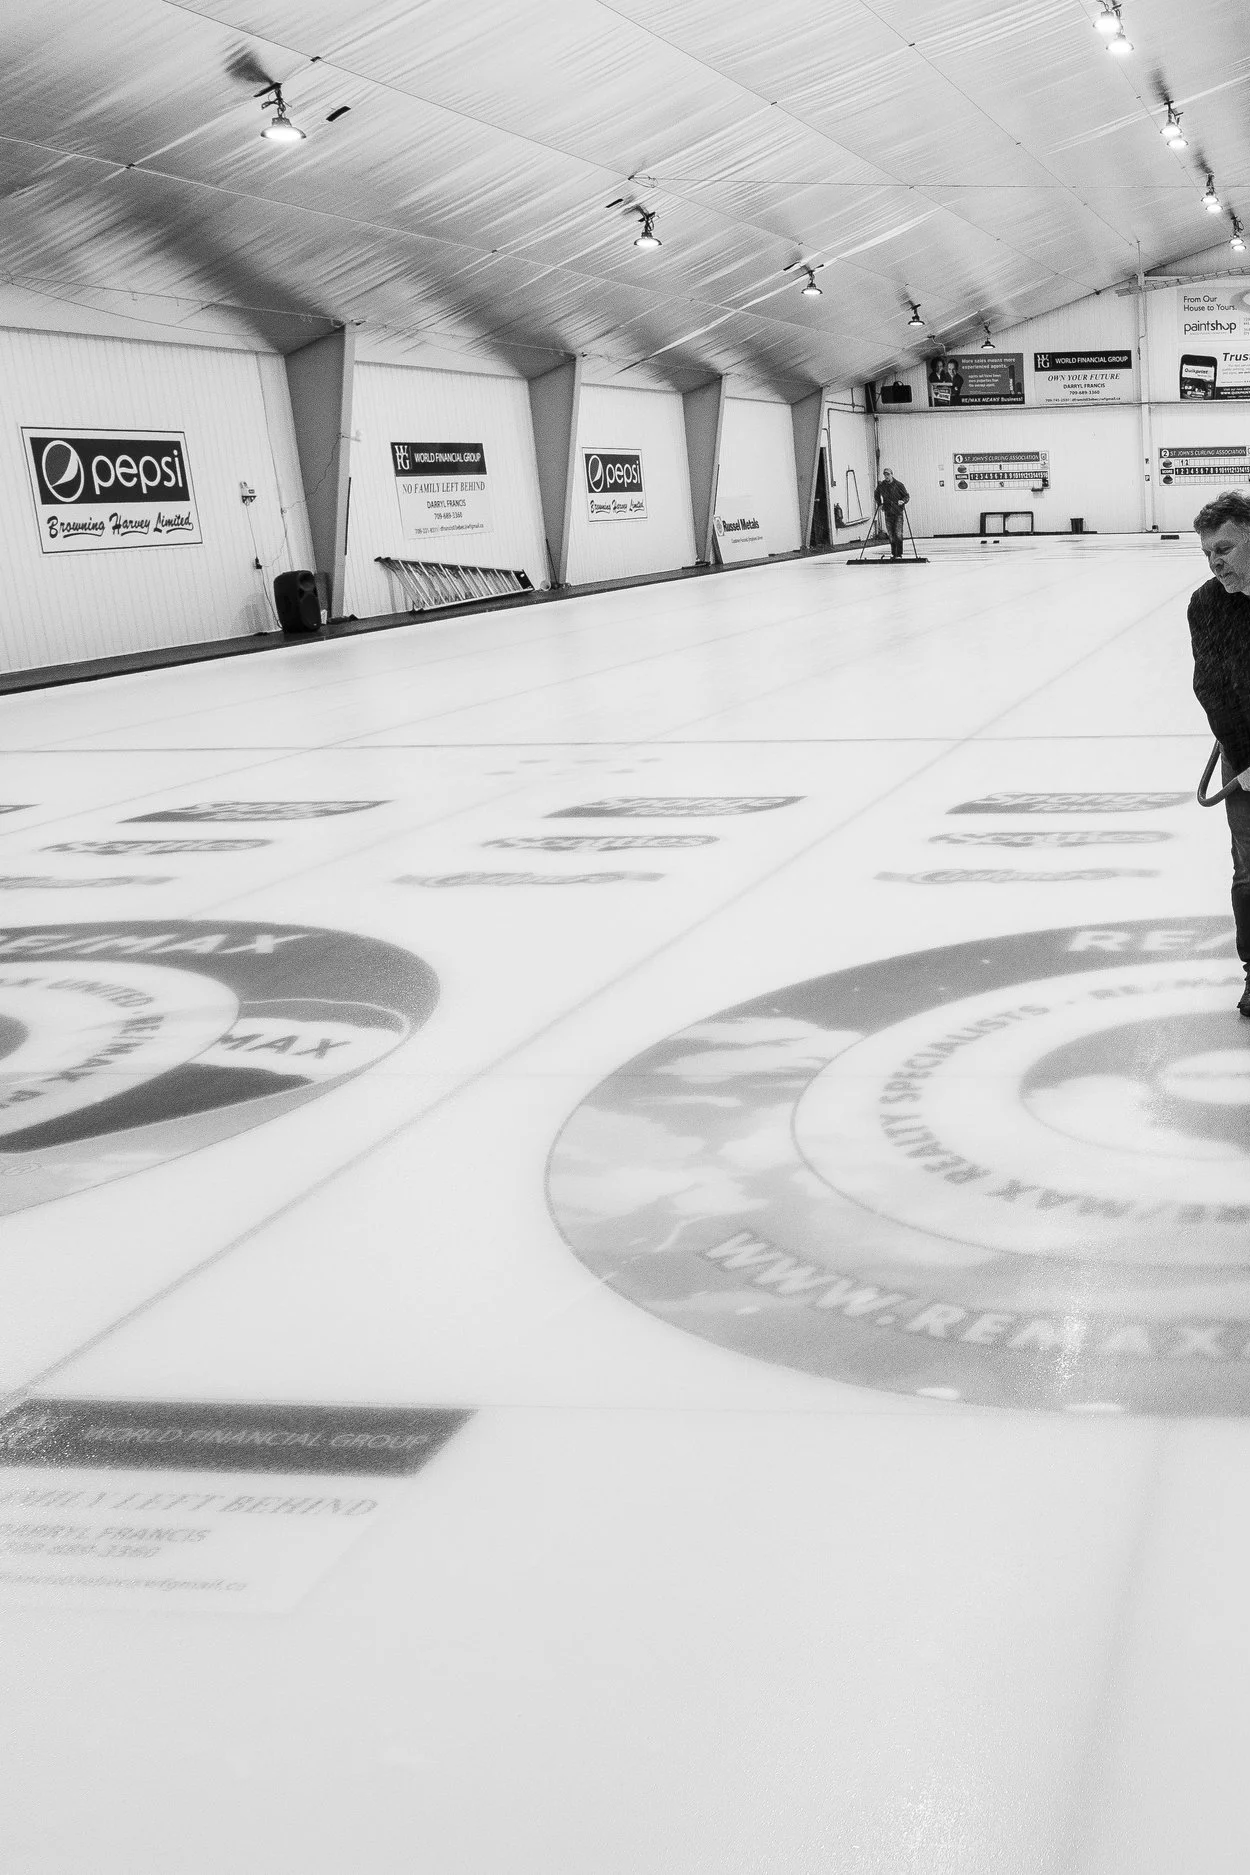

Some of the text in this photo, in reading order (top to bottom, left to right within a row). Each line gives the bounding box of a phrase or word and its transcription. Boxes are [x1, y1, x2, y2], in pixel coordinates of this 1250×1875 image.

[1184, 320, 1236, 335] paintshop
[414, 453, 481, 462] WORLD FINANCIAL GROUP
[92, 450, 184, 494] pepsi
[606, 460, 640, 488] pepsi
[402, 481, 485, 494] NO FAMILY LEFT BEHIND
[447, 499, 466, 508] FRANCIS
[47, 512, 194, 538] Browning Harvey Limited
[740, 518, 759, 530] Metals
[975, 792, 1180, 806] Sponge
[884, 1002, 1051, 1103] SPECIALISTS
[879, 1109, 992, 1185] REALTY
[187, 1427, 329, 1447] FINANCIAL
[328, 1431, 431, 1451] GROUP
[219, 1495, 380, 1516] BEHIND
